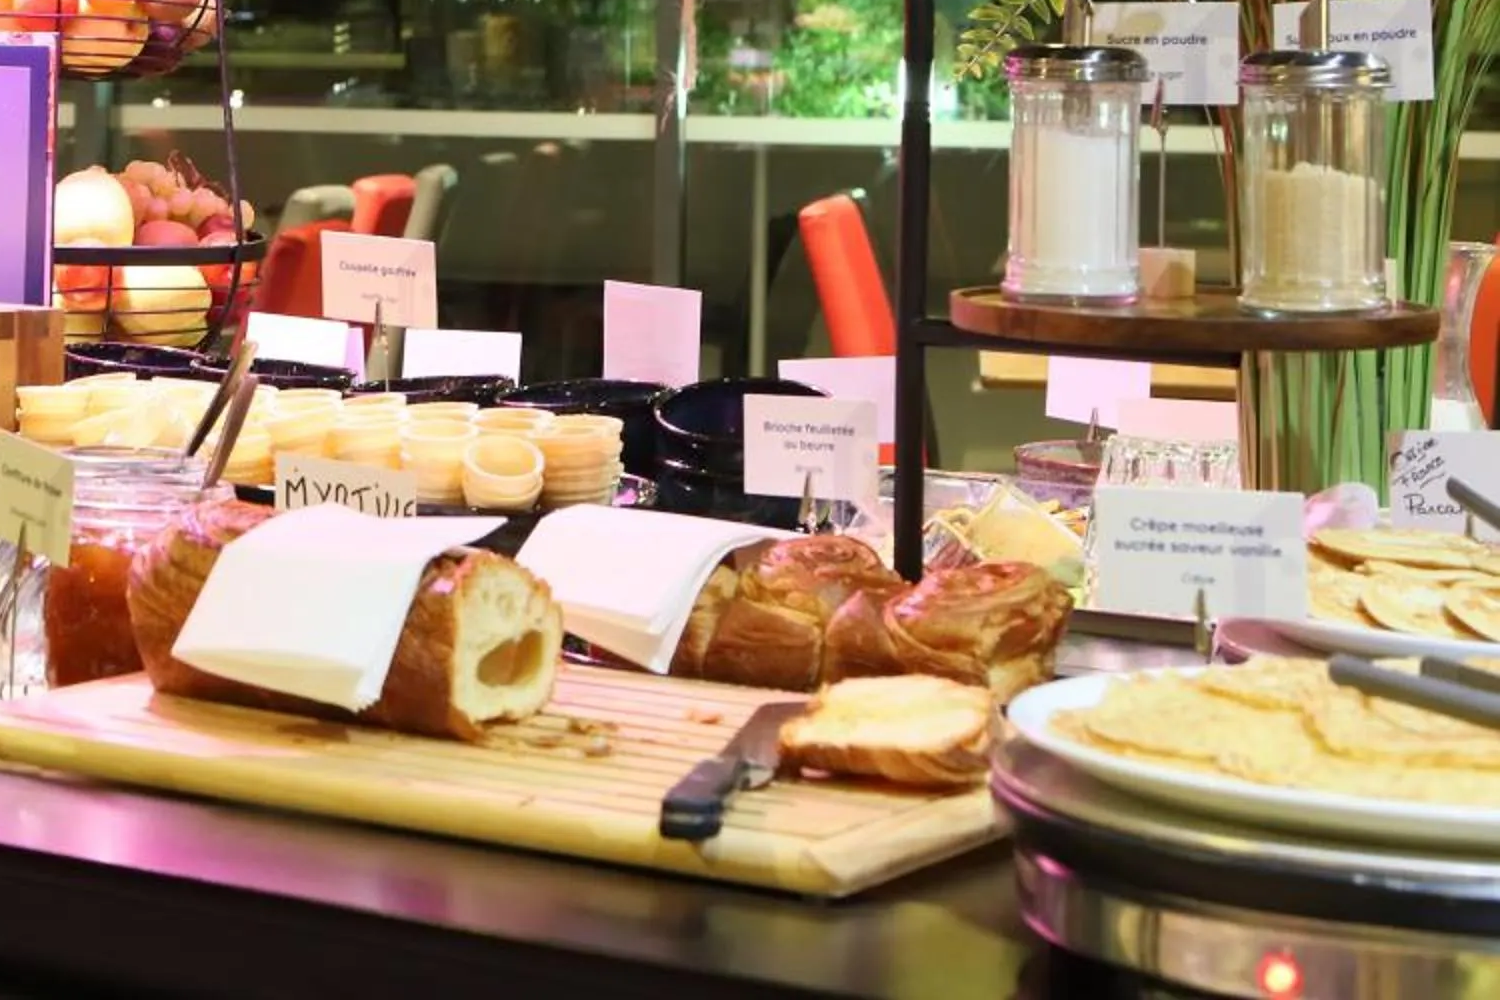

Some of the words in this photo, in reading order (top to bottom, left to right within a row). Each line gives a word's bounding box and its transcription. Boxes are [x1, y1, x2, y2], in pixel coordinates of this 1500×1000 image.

[1107, 33, 1140, 45] Sucre
[1143, 35, 1158, 45] en
[1162, 33, 1207, 47] poudre
[1327, 33, 1350, 42] oux
[1353, 32, 1368, 41] en
[1372, 28, 1417, 42] poudre
[763, 421, 802, 434] Brioche
[804, 422, 855, 436] feuilletée
[800, 439, 835, 452] beurre
[1129, 516, 1178, 535] Crêpe
[1182, 519, 1264, 537] moelleuse
[1114, 538, 1165, 553] sucrée
[1170, 542, 1223, 555] saveur
[1230, 543, 1282, 557] vanille
